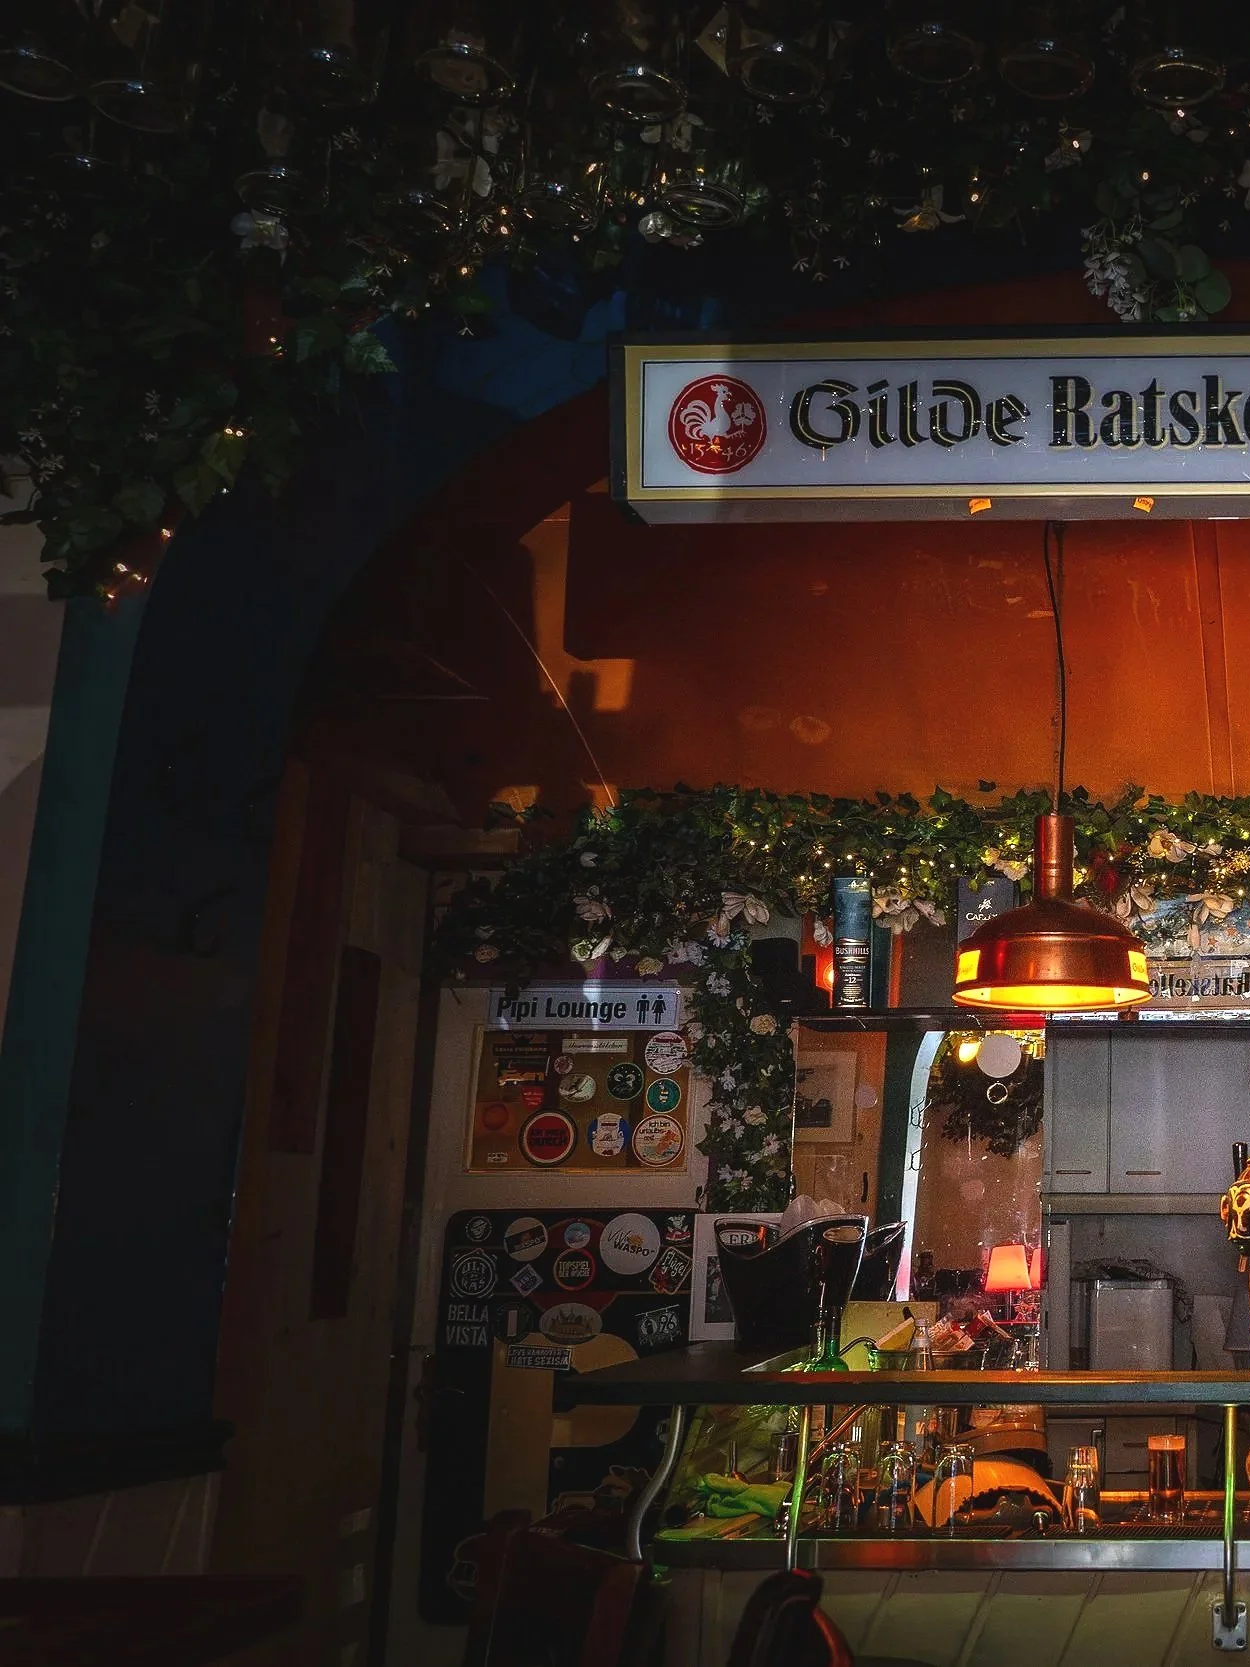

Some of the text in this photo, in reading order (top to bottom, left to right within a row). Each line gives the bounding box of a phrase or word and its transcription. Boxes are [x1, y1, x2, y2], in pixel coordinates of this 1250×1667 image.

[789, 378, 1031, 450] Gilde
[496, 995, 627, 1023] Pipi Lounge
[447, 1304, 489, 1322] BELLA
[446, 1325, 488, 1347] VISTA
